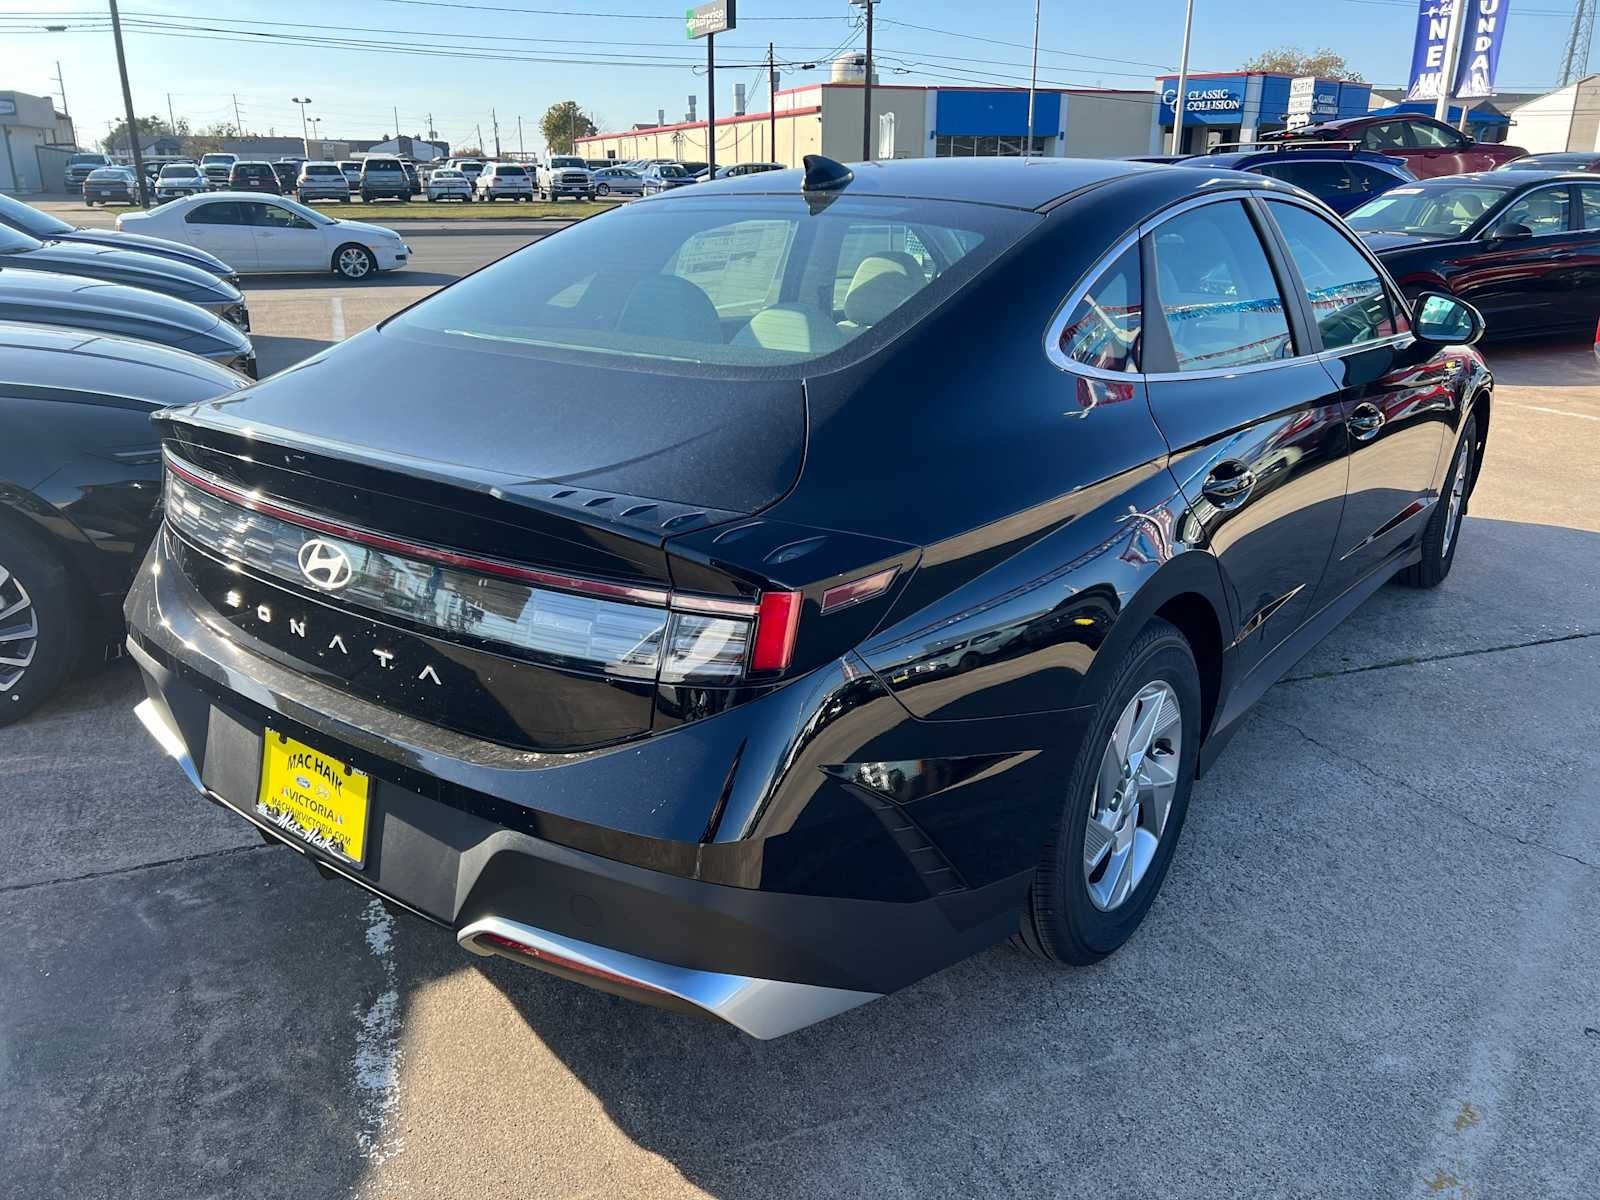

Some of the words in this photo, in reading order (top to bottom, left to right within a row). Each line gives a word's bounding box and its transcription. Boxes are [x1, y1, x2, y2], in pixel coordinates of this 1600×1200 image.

[1186, 99, 1241, 112] COLLISION
[1188, 88, 1229, 101] CLASSIC
[225, 589, 443, 687] SONATA
[287, 753, 312, 771] MAC
[314, 757, 343, 798] HAIK
[288, 787, 335, 822] VICTORIA
